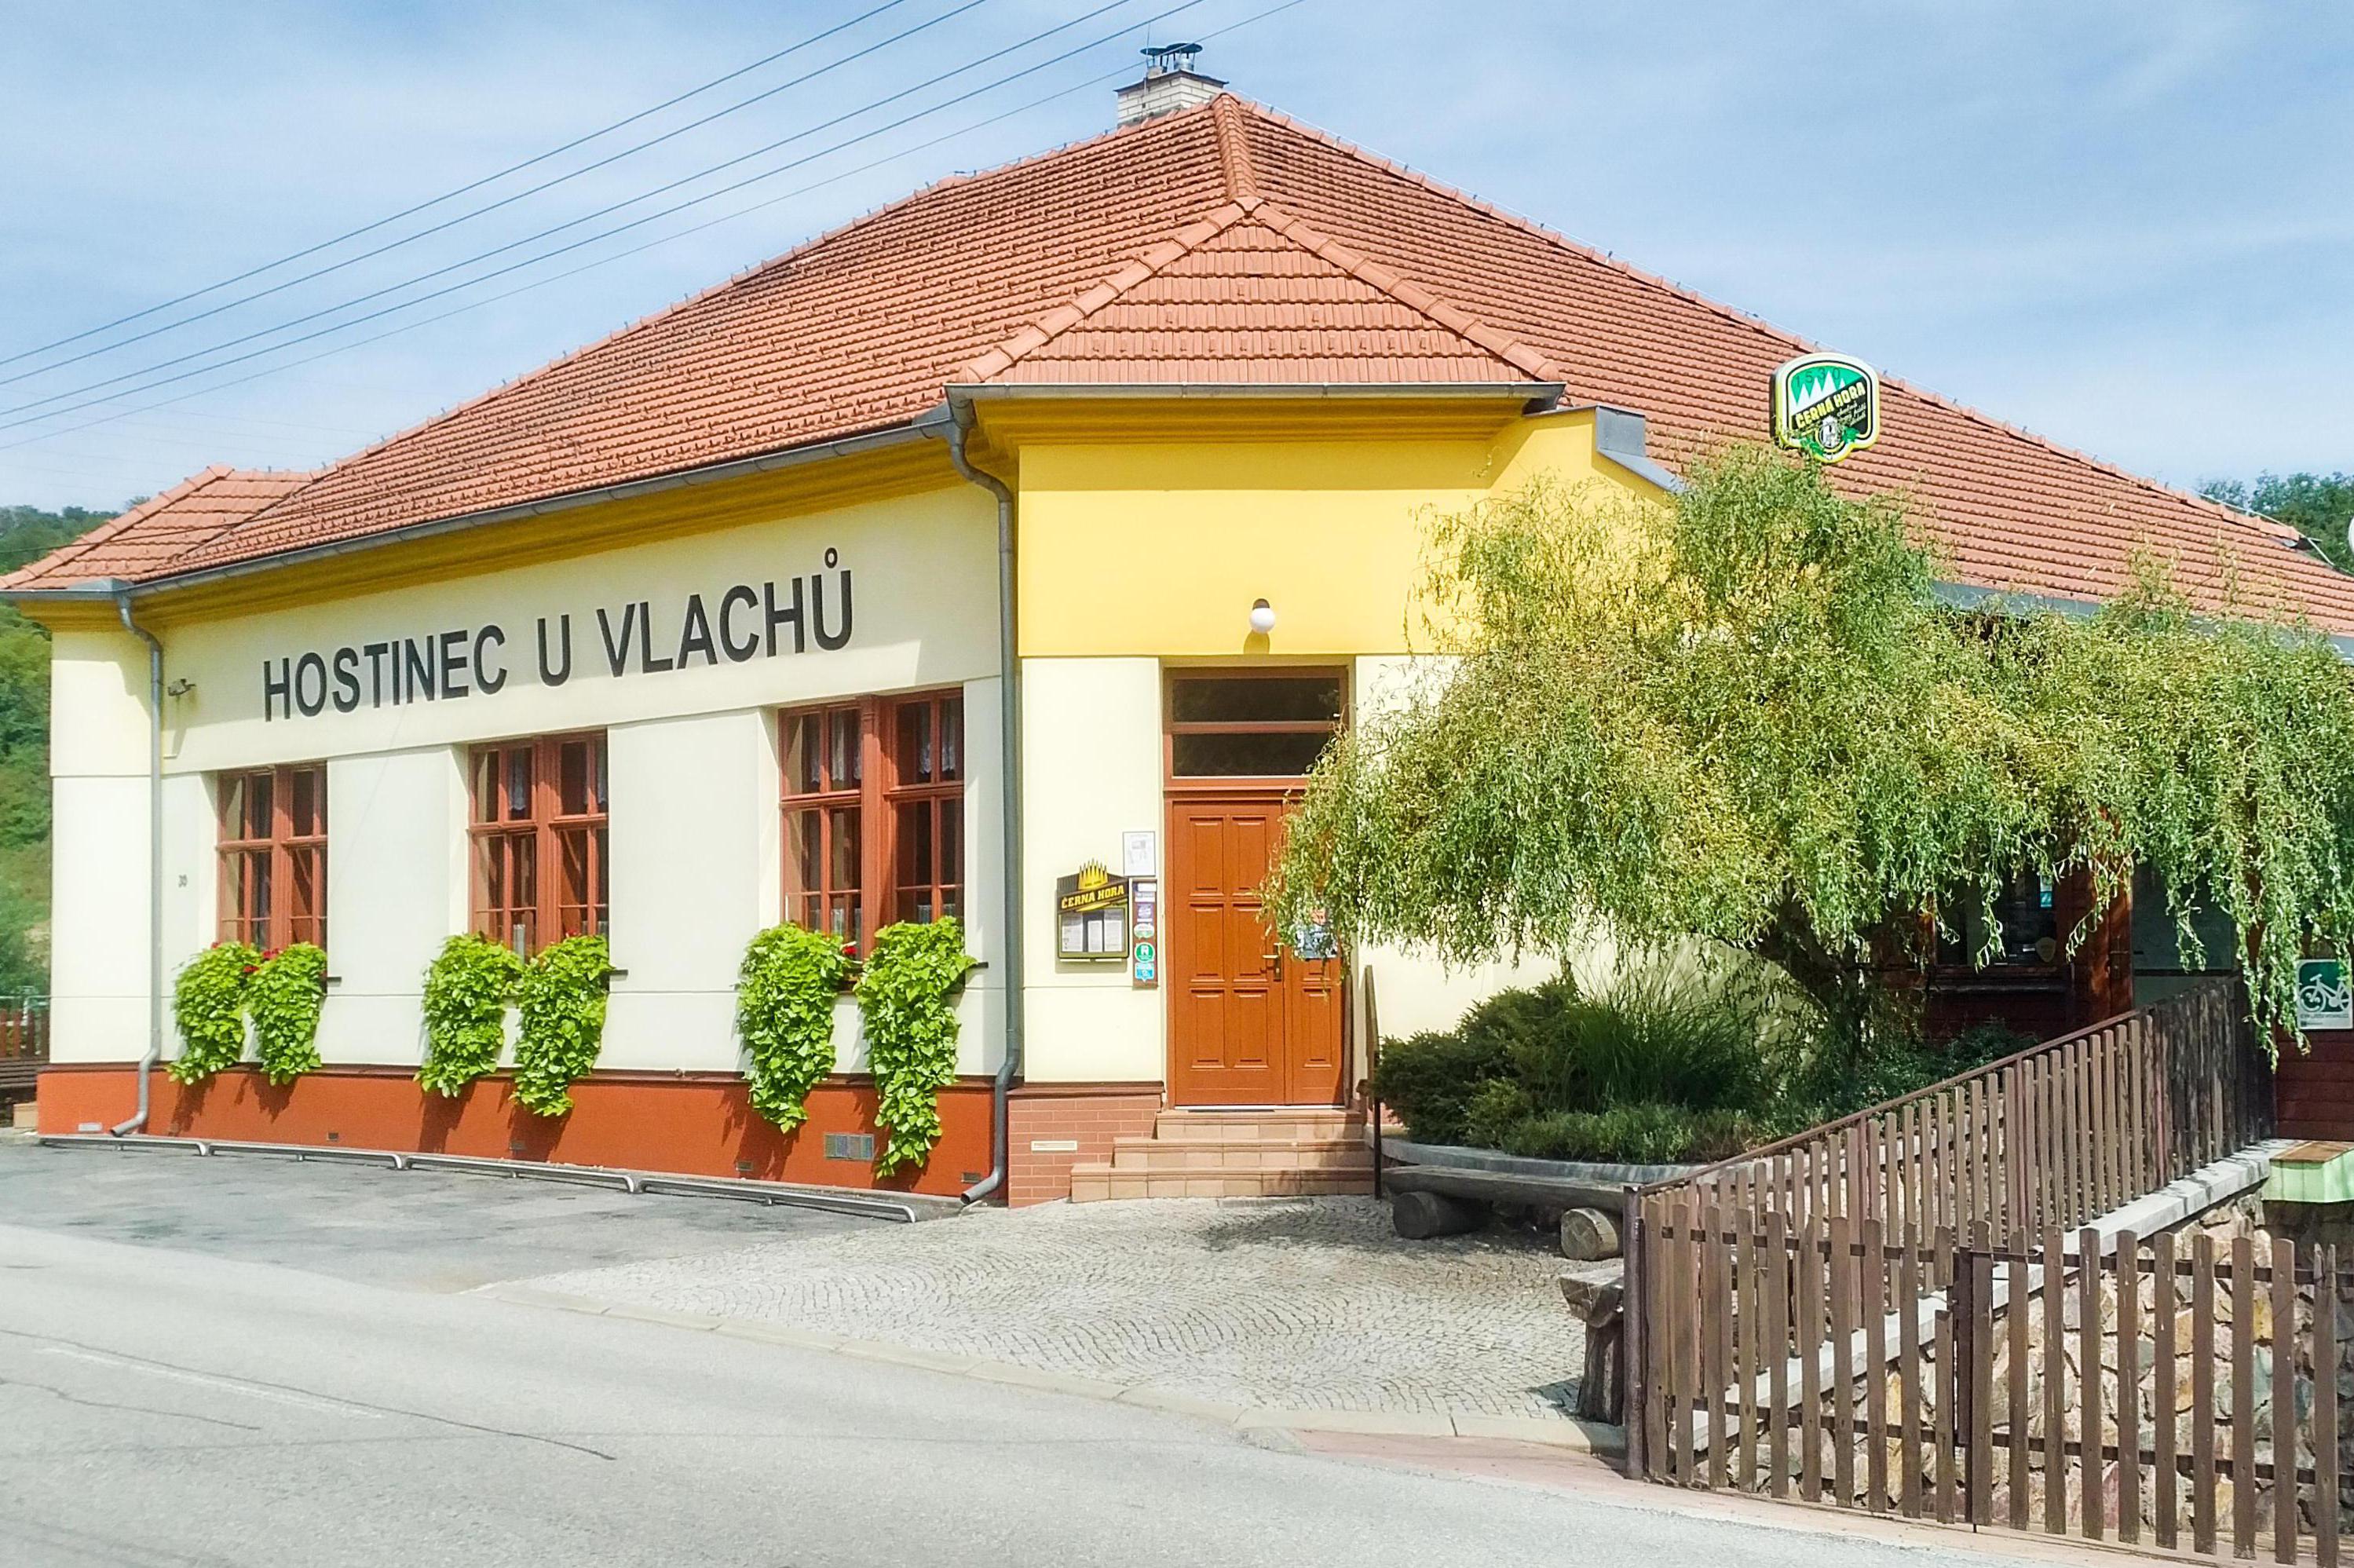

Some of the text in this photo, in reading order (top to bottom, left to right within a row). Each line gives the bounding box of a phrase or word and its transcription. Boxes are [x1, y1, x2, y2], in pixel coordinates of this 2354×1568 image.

[1795, 367, 1840, 387] 1530
[1833, 382, 1866, 408] HORA
[263, 546, 853, 722] HOSTINEC U VLACHŮ
[1097, 884, 1125, 901] HORA
